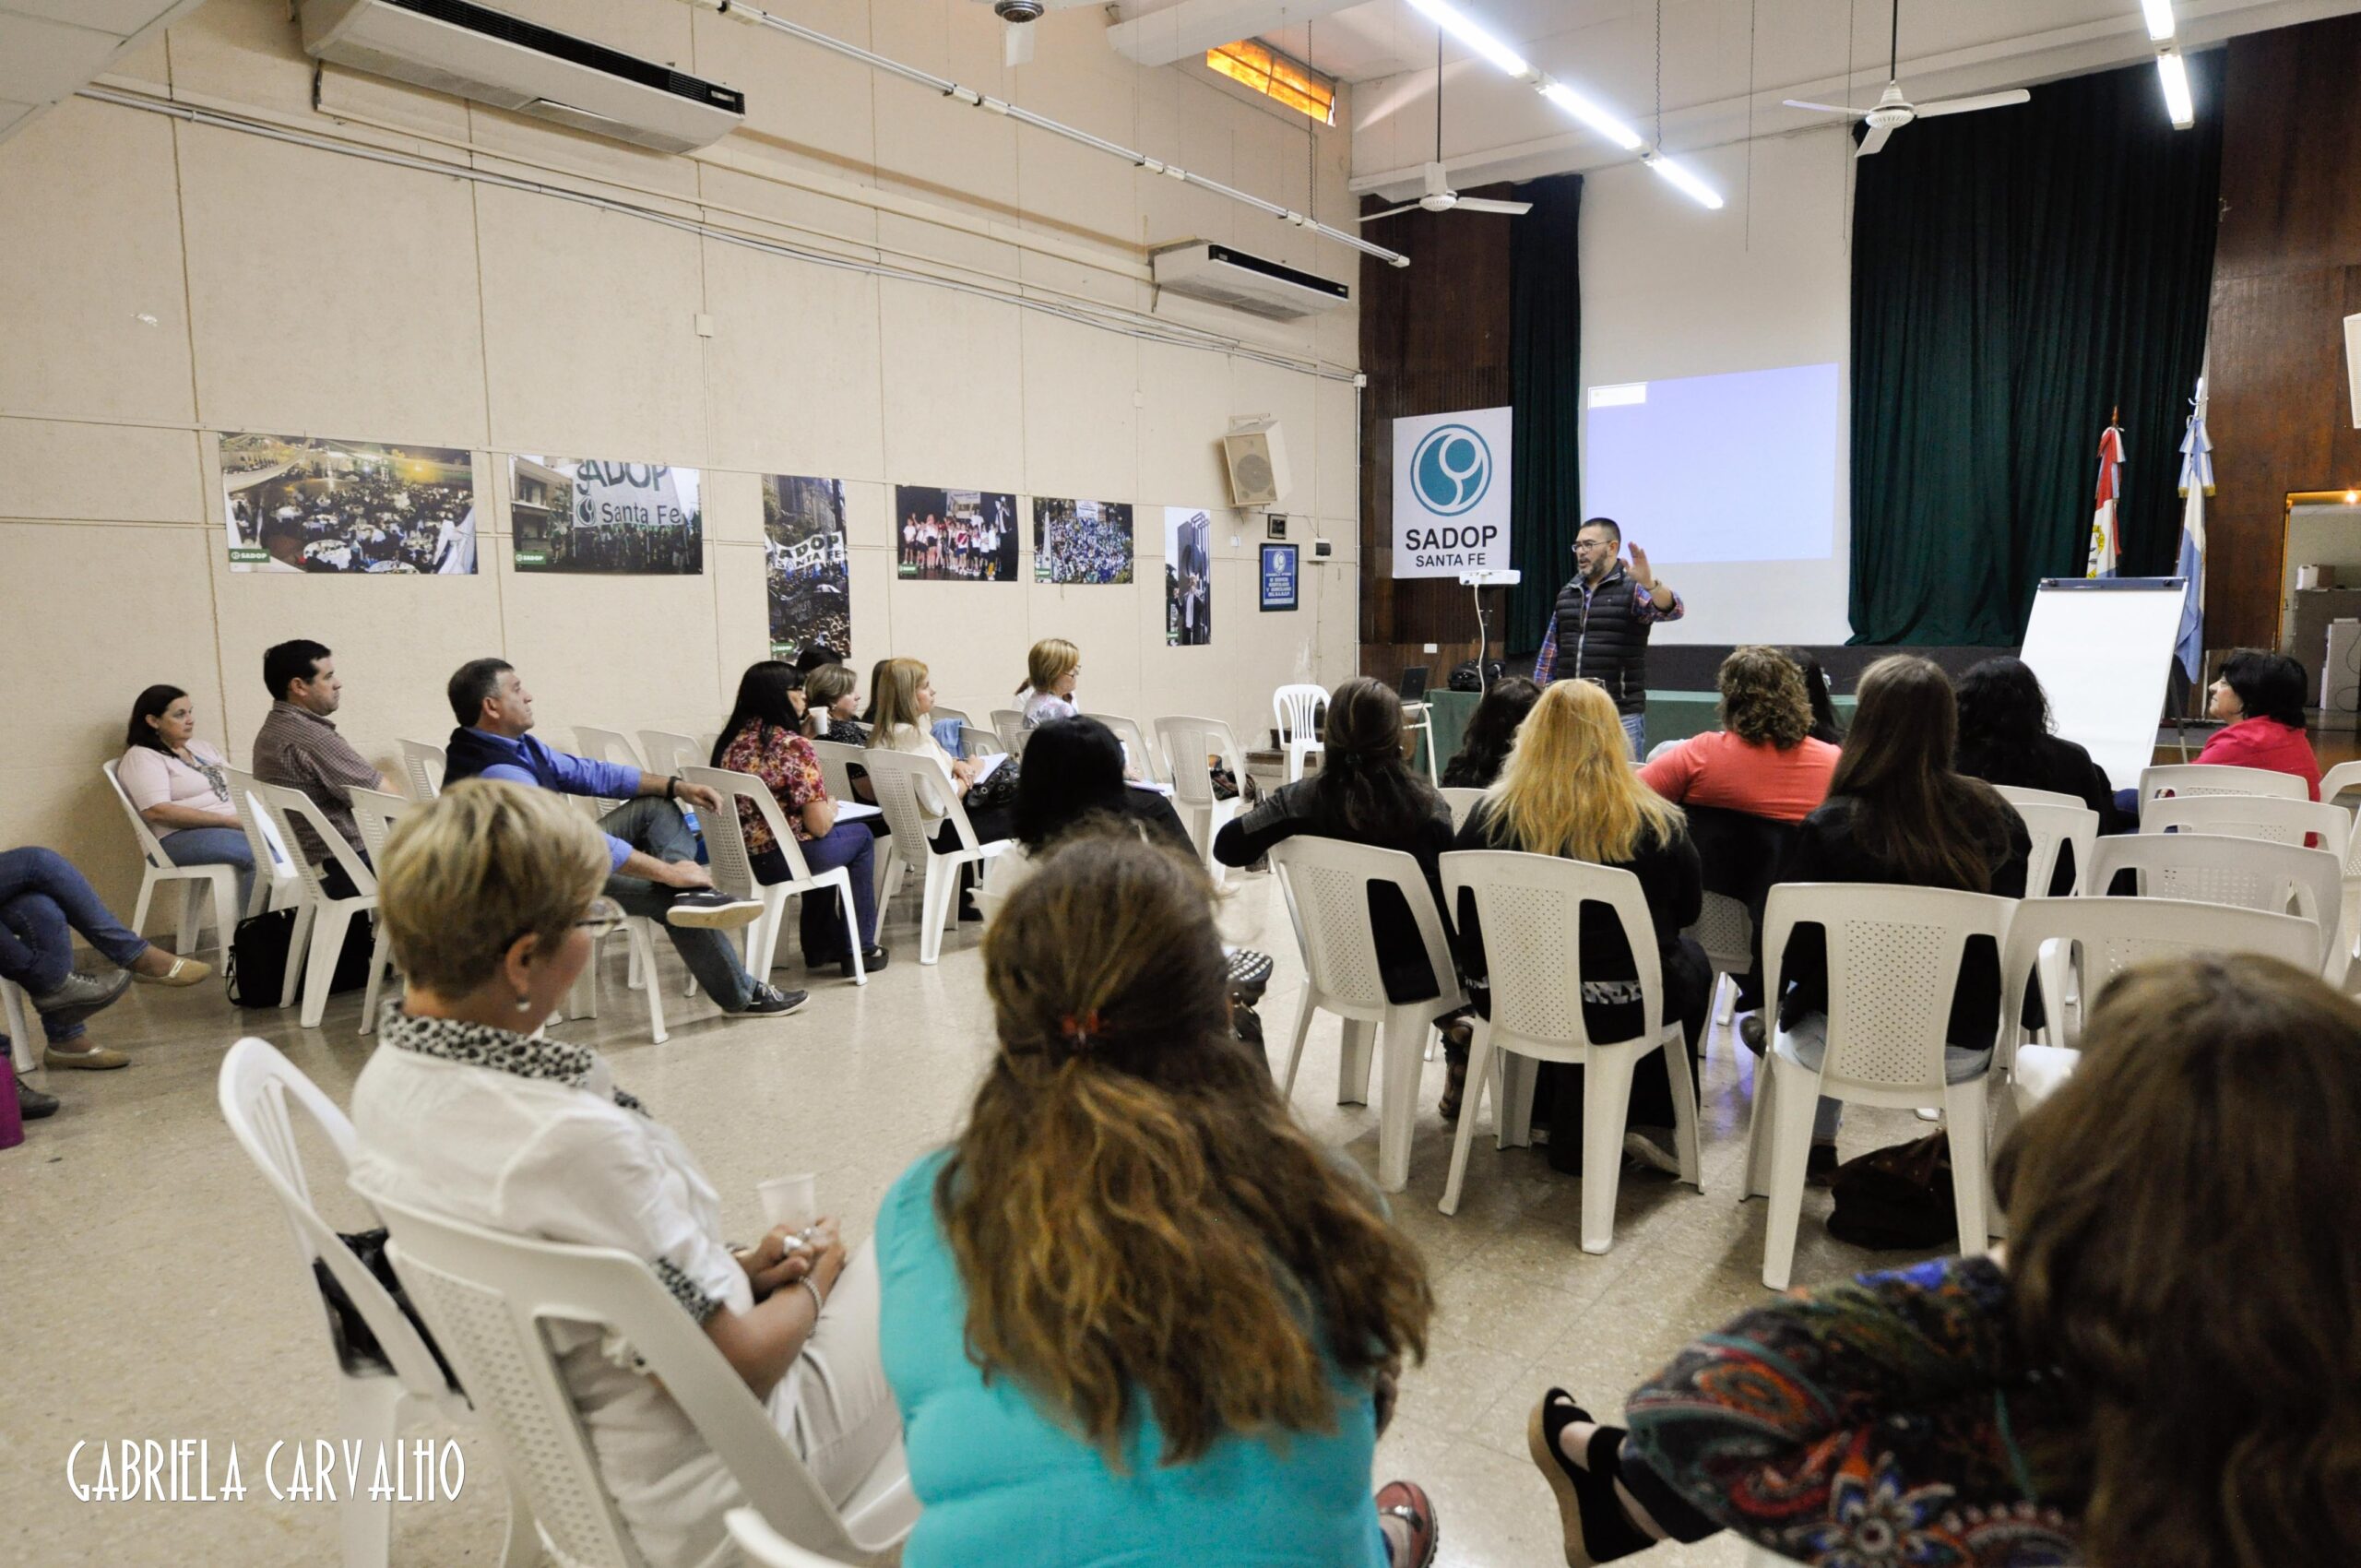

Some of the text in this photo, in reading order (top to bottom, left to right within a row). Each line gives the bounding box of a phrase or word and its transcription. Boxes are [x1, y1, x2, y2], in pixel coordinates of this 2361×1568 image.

[601, 502, 681, 524] Santa Fe
[775, 535, 839, 559] ADOP
[1406, 525, 1498, 551] SADOP
[1416, 552, 1486, 567] SANTA FE
